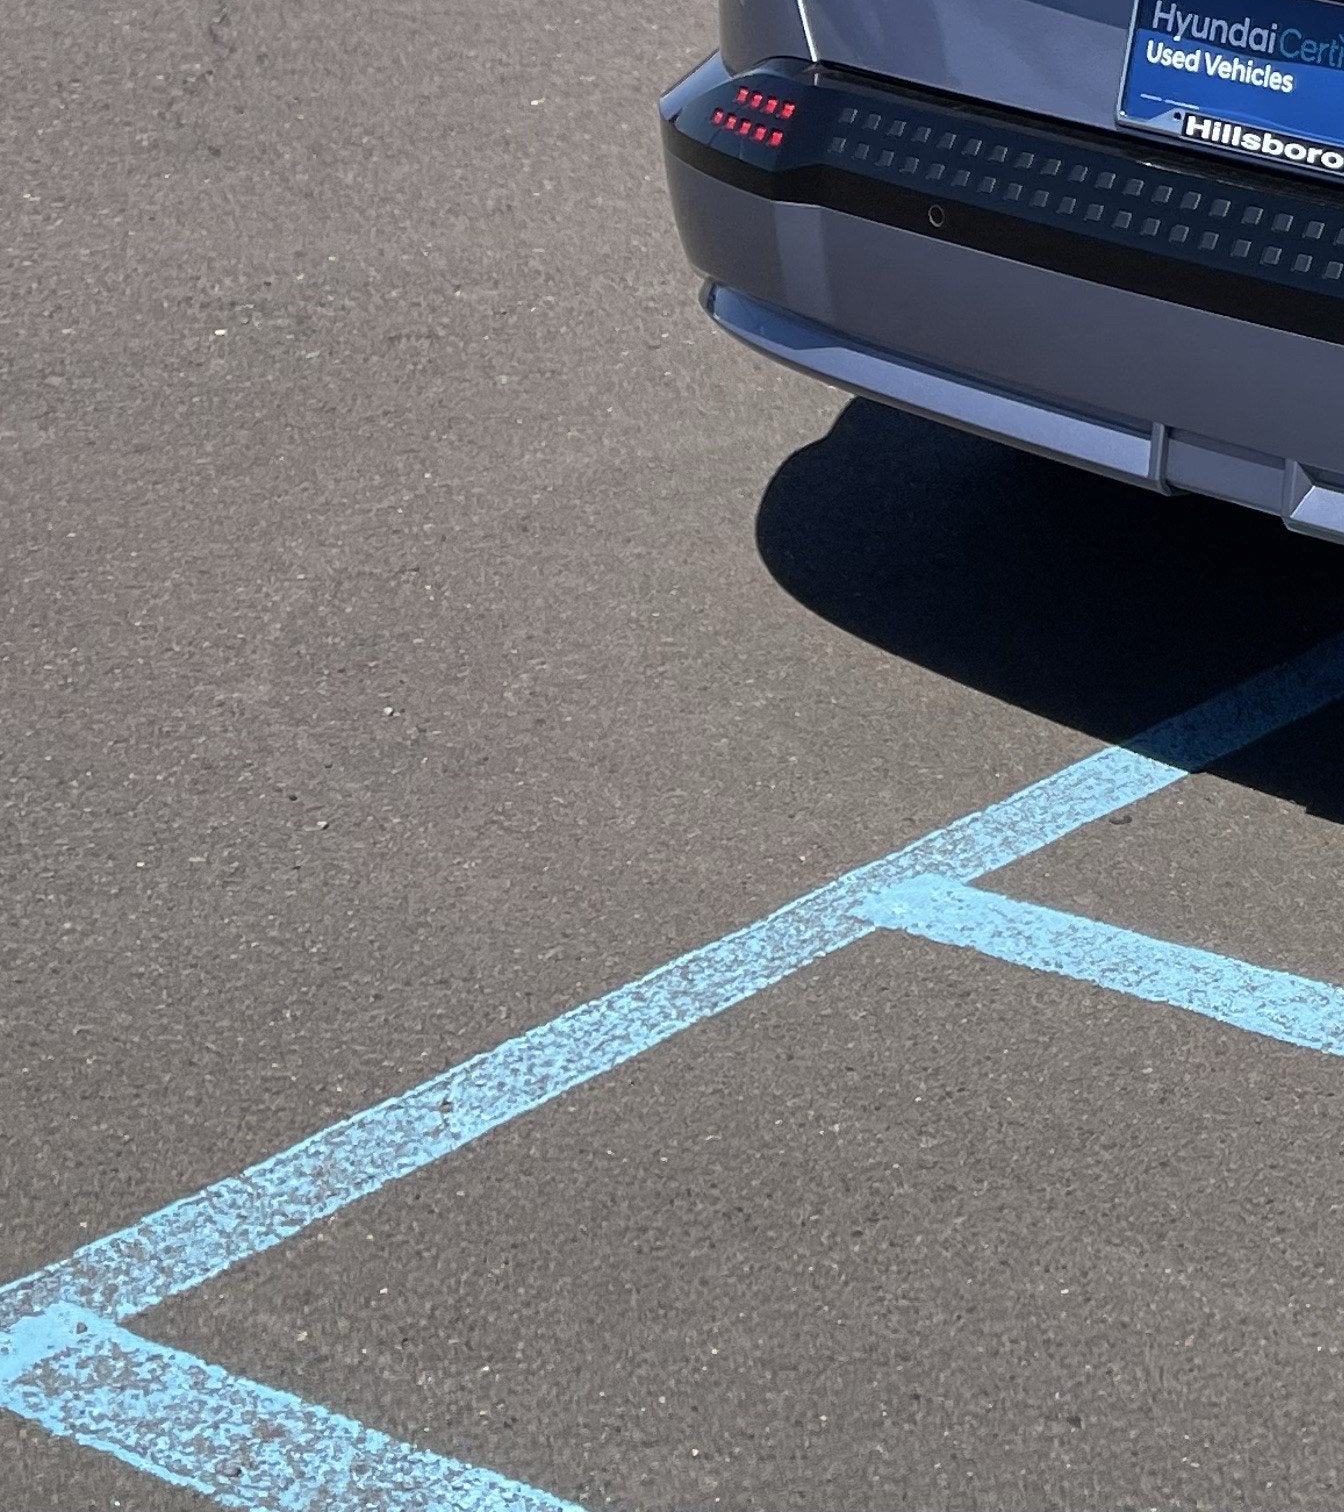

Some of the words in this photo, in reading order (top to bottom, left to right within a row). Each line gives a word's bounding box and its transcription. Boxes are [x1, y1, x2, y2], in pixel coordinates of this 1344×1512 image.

[1152, 0, 1277, 53] Hyundai
[1146, 40, 1200, 73] Used
[1205, 51, 1294, 93] Vehicles
[1186, 115, 1344, 169] Hillsboro
